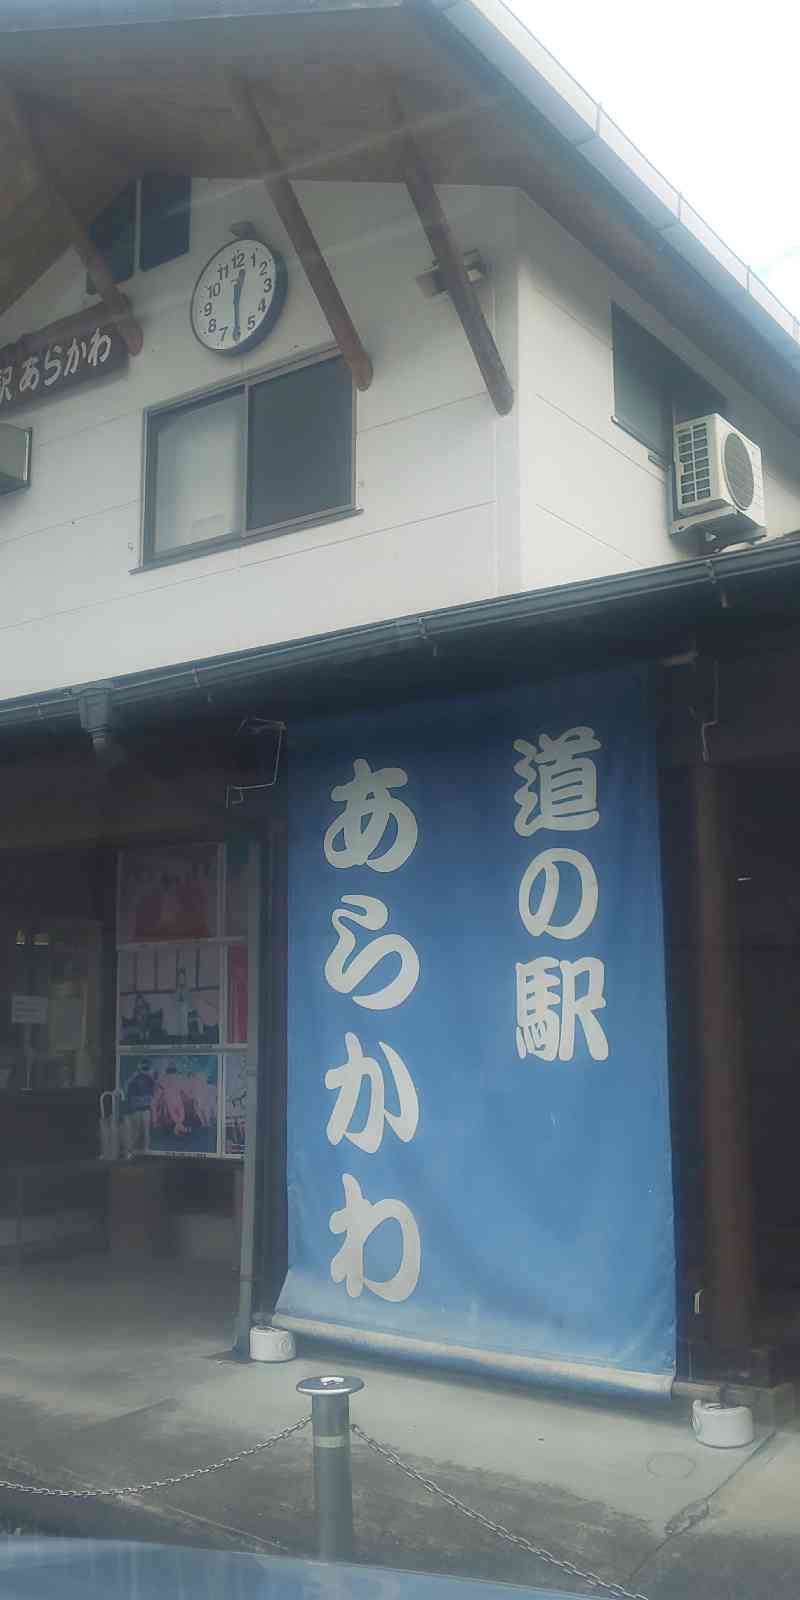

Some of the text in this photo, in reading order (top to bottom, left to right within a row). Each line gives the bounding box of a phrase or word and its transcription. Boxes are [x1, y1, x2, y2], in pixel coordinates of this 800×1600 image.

[232, 253, 245, 269] 12
[251, 253, 256, 268] 1
[259, 261, 268, 276] 2
[217, 264, 229, 281] 11
[207, 283, 221, 299] 10
[264, 278, 272, 293] 3
[203, 302, 212, 317] 9
[258, 298, 266, 312] 4
[208, 319, 217, 333] 8
[248, 315, 256, 331] 5
[218, 326, 228, 342] 7
[512, 726, 609, 1061] 道の駅
[323, 758, 421, 1303] あらかわ
